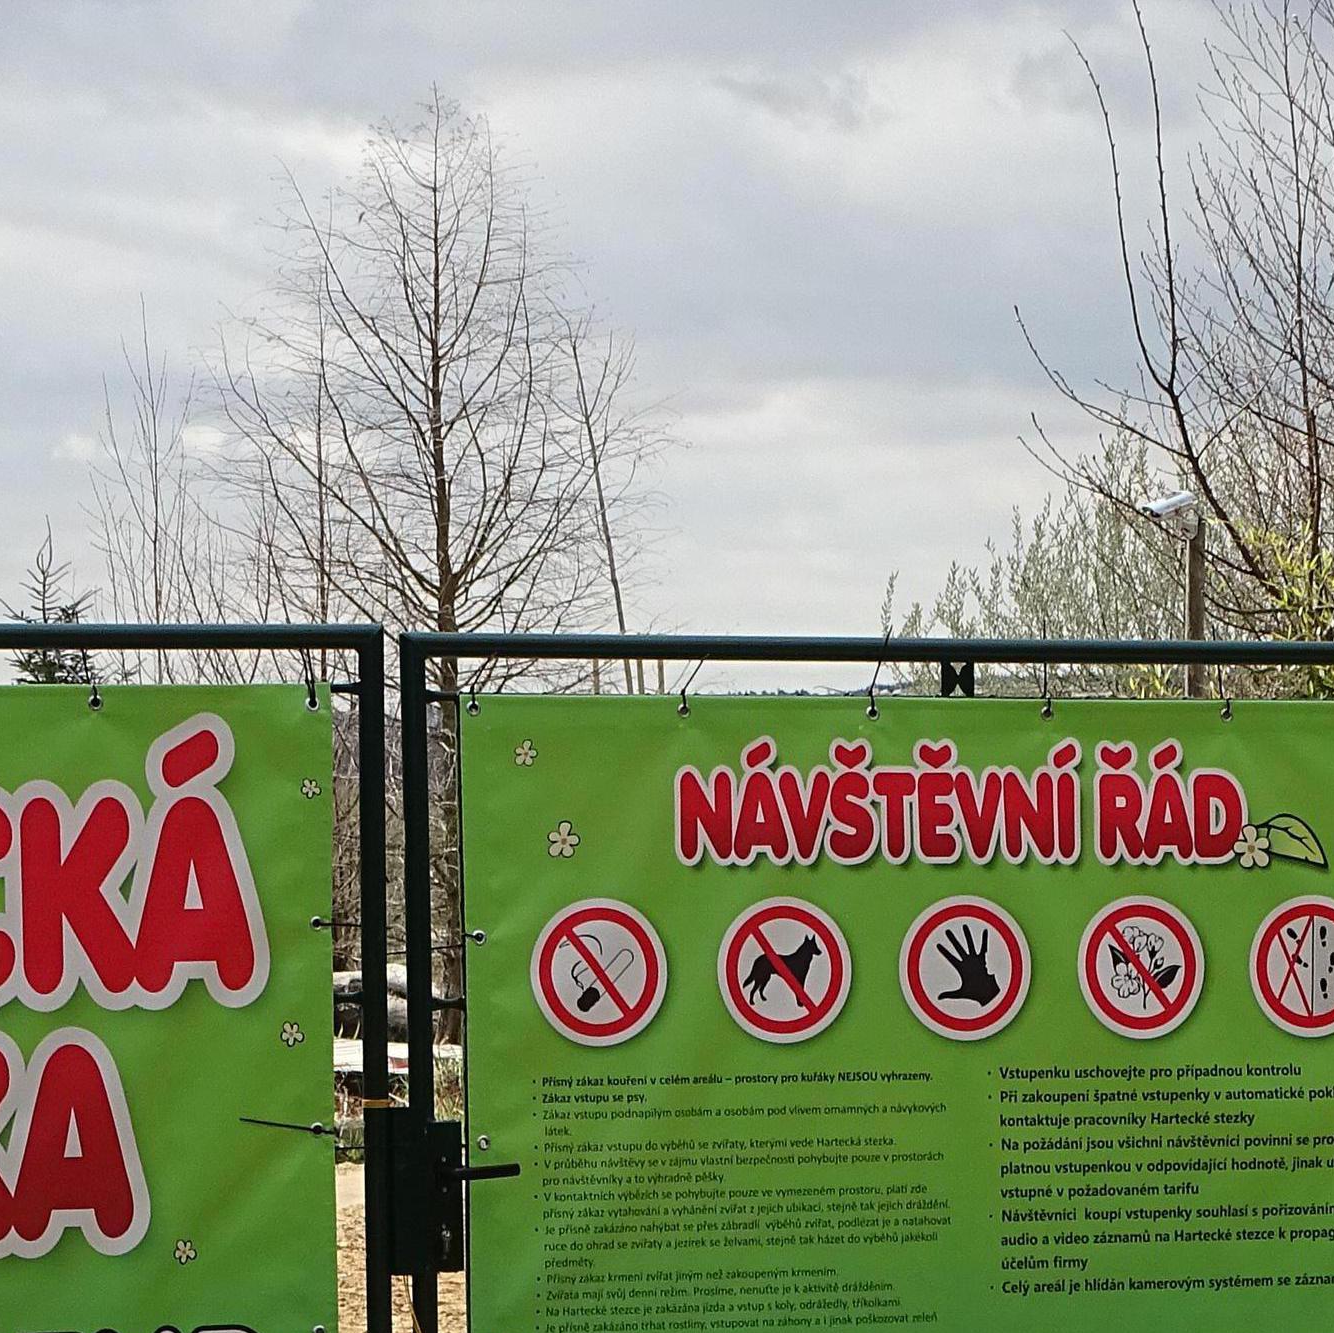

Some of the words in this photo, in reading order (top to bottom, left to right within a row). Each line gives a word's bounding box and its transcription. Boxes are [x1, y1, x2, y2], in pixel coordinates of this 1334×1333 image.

[676, 738, 1079, 866] NÁVŠTĚVNÍ
[1094, 740, 1247, 866] ŘÁD
[543, 1075, 573, 1089] Přísný
[575, 1075, 604, 1087] zákaz
[607, 1075, 647, 1086] kouření
[649, 1077, 656, 1085] v
[659, 1073, 690, 1085] celém
[693, 1073, 722, 1084] areálu
[735, 1074, 778, 1085] prostory
[781, 1074, 798, 1084] pro
[801, 1071, 835, 1084] kuřáky
[837, 1070, 877, 1082] NEJSOU
[879, 1070, 933, 1083] vyhrazeny.
[999, 1065, 1070, 1083] Vstupenku
[1075, 1064, 1145, 1081] uschovejte
[1149, 1068, 1172, 1081] pro
[1177, 1063, 1242, 1081] případnou
[1247, 1062, 1301, 1076] kontrolu
[541, 1092, 571, 1103] Zákaz
[573, 1093, 609, 1105] vstupu
[611, 1094, 623, 1102] se
[627, 1093, 647, 1104] psy.
[1001, 1090, 1017, 1103] Při
[1021, 1088, 1089, 1106] zakoupení
[1093, 1088, 1137, 1105] špatné
[1141, 1087, 1210, 1105] vstupenky
[1213, 1091, 1221, 1100] v
[1225, 1085, 1304, 1100] automatické
[999, 1113, 1070, 1129] kontaktuje
[1073, 1111, 1146, 1129] pracovníky
[1151, 1111, 1210, 1125] Hartecké
[1213, 1110, 1255, 1127] stezky
[1001, 1137, 1019, 1151] Na
[1023, 1136, 1082, 1154] požádání
[1085, 1136, 1113, 1153] jsou
[1117, 1135, 1162, 1149] všichni
[1167, 1133, 1239, 1148] návštěvníci
[1243, 1133, 1292, 1150] povinni
[1295, 1136, 1309, 1146] se
[1001, 1161, 1050, 1178] platnou
[1055, 1159, 1131, 1177] vstupenkou
[1136, 1162, 1143, 1172] v
[1147, 1157, 1227, 1175] odpovídající
[1231, 1156, 1288, 1171] hodnotě,
[1291, 1155, 1322, 1172] jinak
[1001, 1184, 1053, 1201] vstupné
[1057, 1187, 1064, 1197] v
[1067, 1182, 1159, 1201] požadovaném
[1163, 1181, 1199, 1195] tarifu
[1001, 1207, 1076, 1223] Návštěvníci
[1085, 1207, 1121, 1224] koupí
[1125, 1205, 1192, 1223] vstupenky
[1195, 1203, 1248, 1218] souhlasí
[1251, 1207, 1258, 1217] s
[1001, 1232, 1038, 1246] audio
[1041, 1235, 1049, 1245] a
[1053, 1231, 1089, 1245] video
[1093, 1228, 1150, 1244] záznamů
[1155, 1232, 1170, 1242] na
[1175, 1227, 1232, 1242] Hartecké
[1235, 1228, 1274, 1240] stezce
[1279, 1226, 1286, 1240] k
[1001, 1255, 1049, 1270] účelům
[1053, 1255, 1088, 1272] firmy
[1001, 1279, 1030, 1297] Celý
[1033, 1279, 1065, 1293] areál
[1067, 1278, 1080, 1295] je
[1085, 1277, 1124, 1292] hlídán
[1129, 1275, 1204, 1293] kamerovým
[1209, 1274, 1273, 1291] systémem
[1277, 1276, 1291, 1286] se
